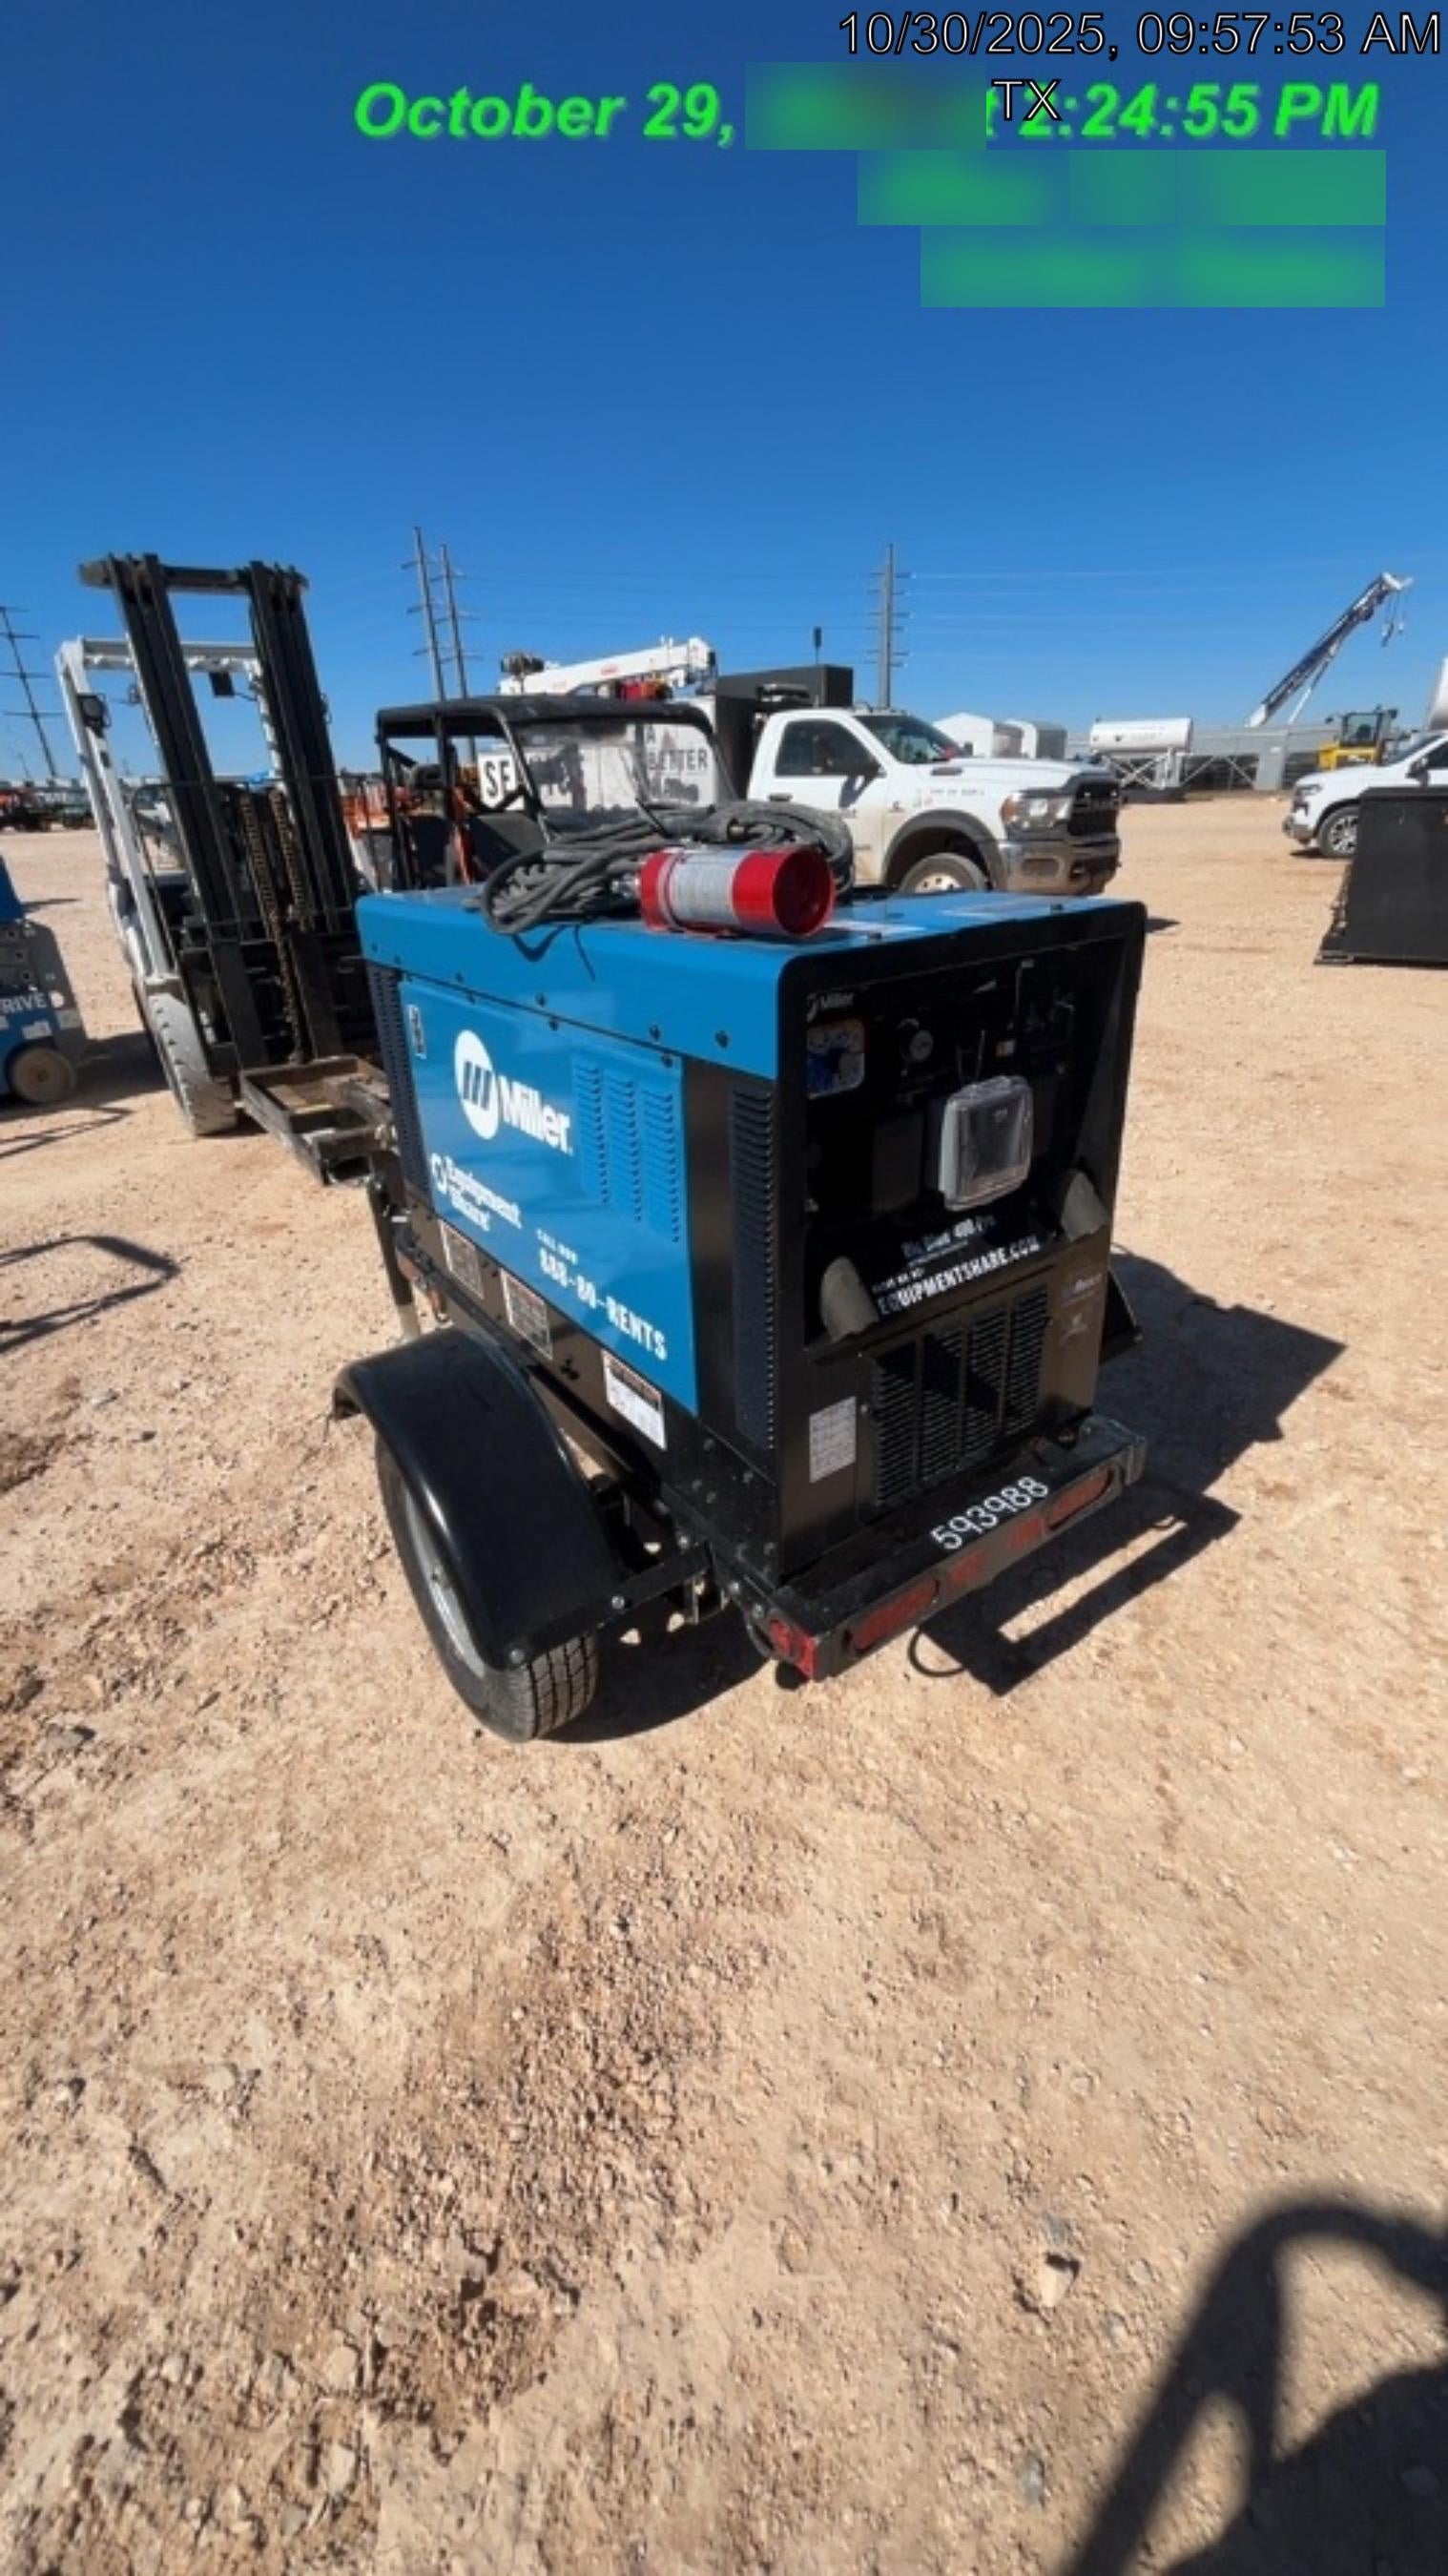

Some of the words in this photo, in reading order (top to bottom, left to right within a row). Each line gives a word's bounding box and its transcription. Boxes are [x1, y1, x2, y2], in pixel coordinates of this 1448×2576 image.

[647, 748, 708, 772] BETTER
[0, 992, 47, 1013] RIVE
[498, 1074, 572, 1155] Miller
[878, 1236, 1041, 1316] EQUIPMENTSHARE.COM
[929, 1476, 1049, 1550] 593988
